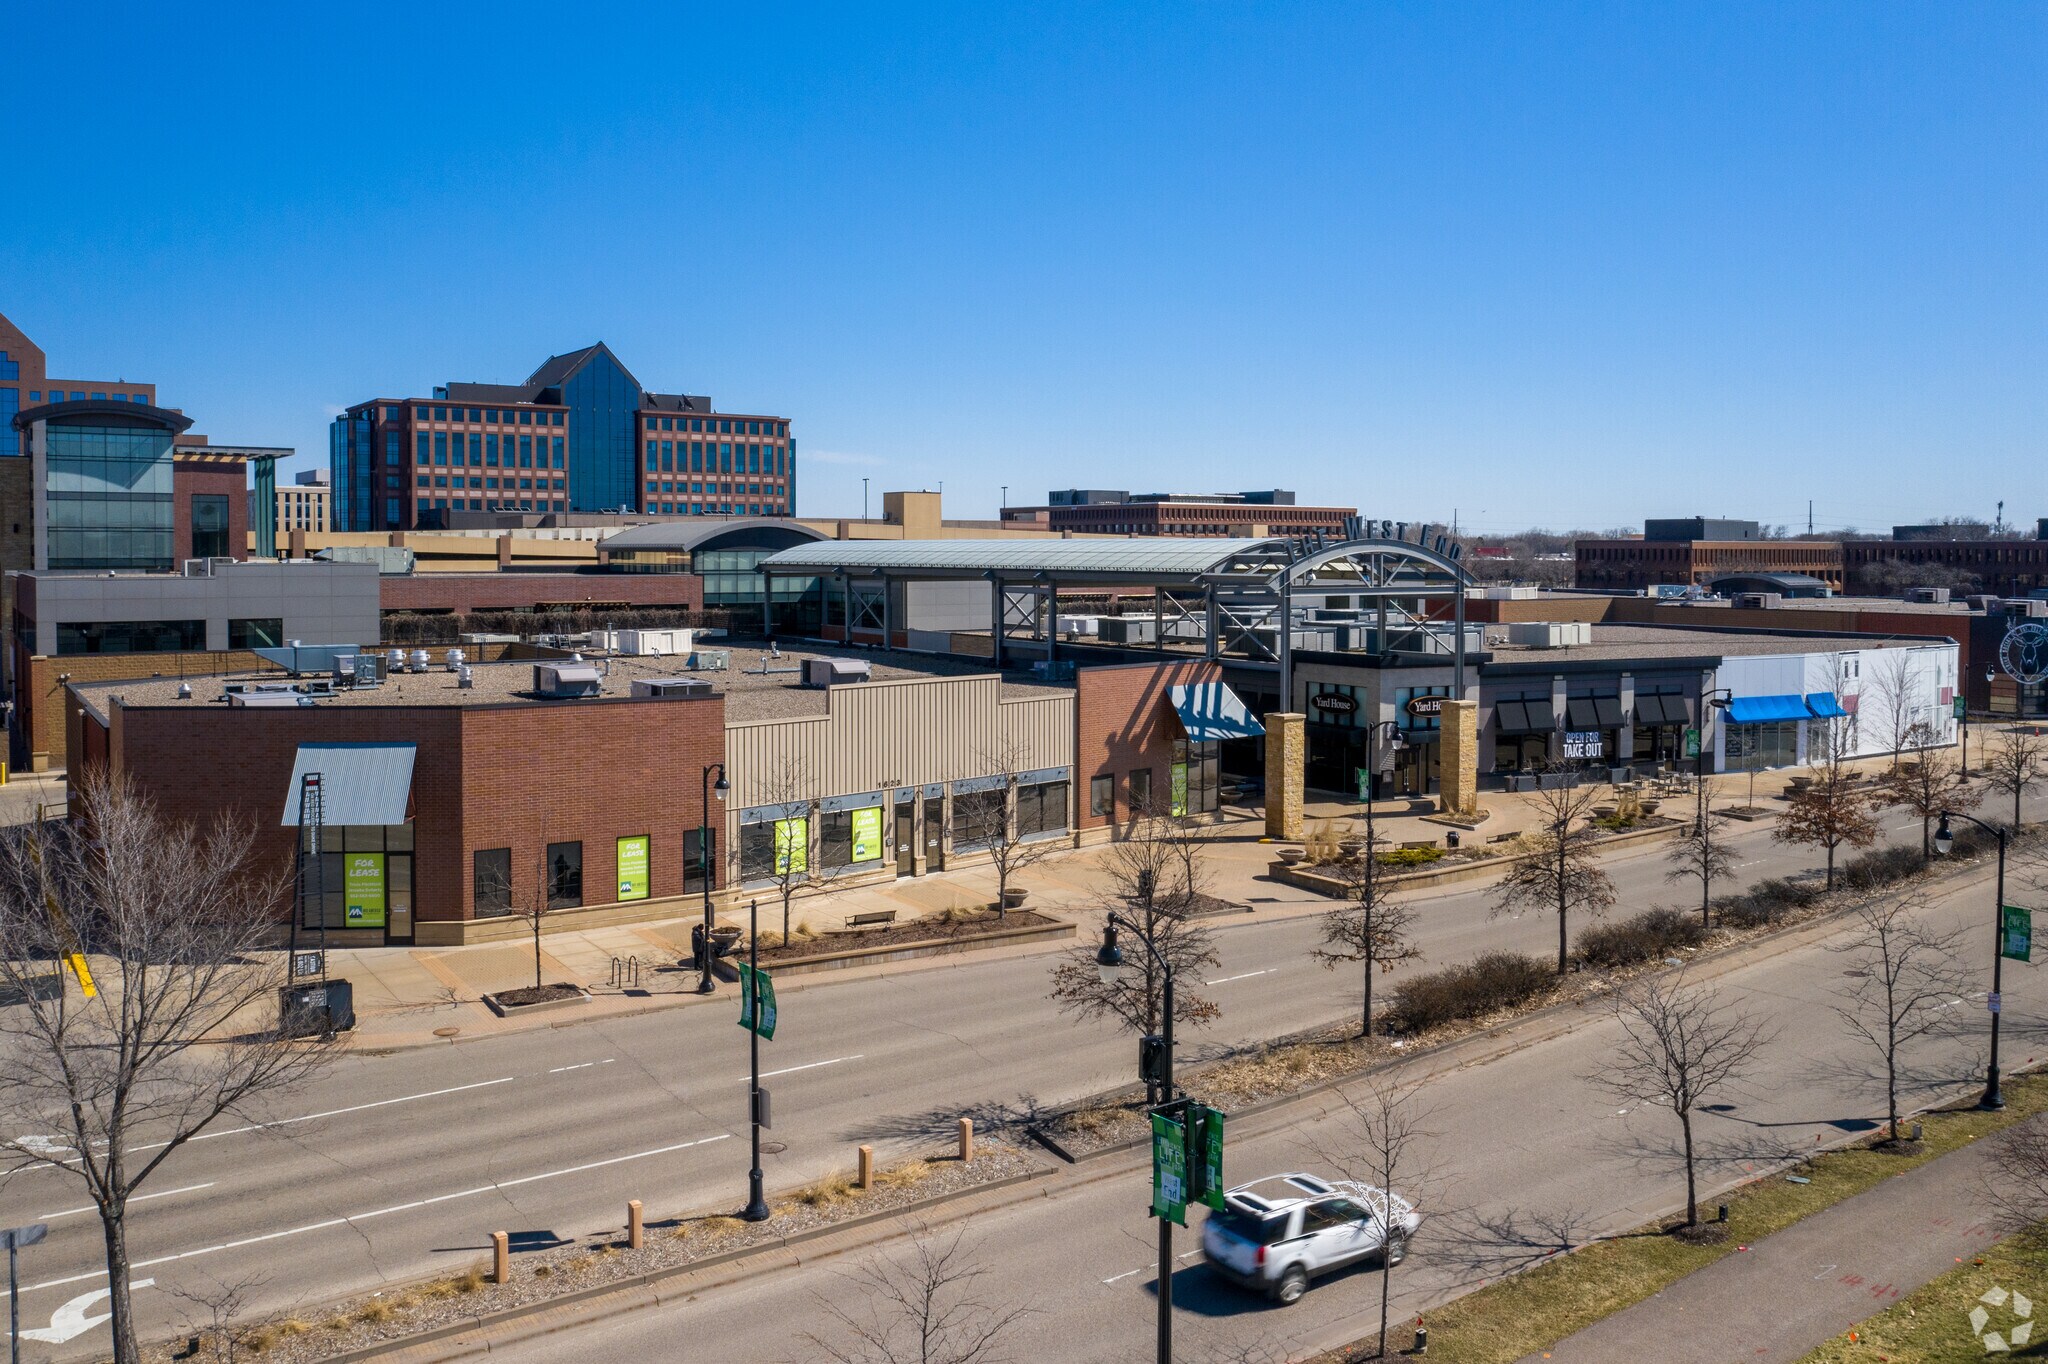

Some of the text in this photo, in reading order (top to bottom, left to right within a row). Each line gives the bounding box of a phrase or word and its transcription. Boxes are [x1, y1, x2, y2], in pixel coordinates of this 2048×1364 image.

[1284, 516, 1462, 564] THE WEST END
[1316, 697, 1350, 710] Yard House
[1414, 702, 1432, 712] Yard
[1566, 732, 1598, 743] OPEN FOR
[1563, 743, 1602, 758] TAKE OUT
[878, 780, 901, 788] 1623
[1159, 1146, 1180, 1165] LIFE
